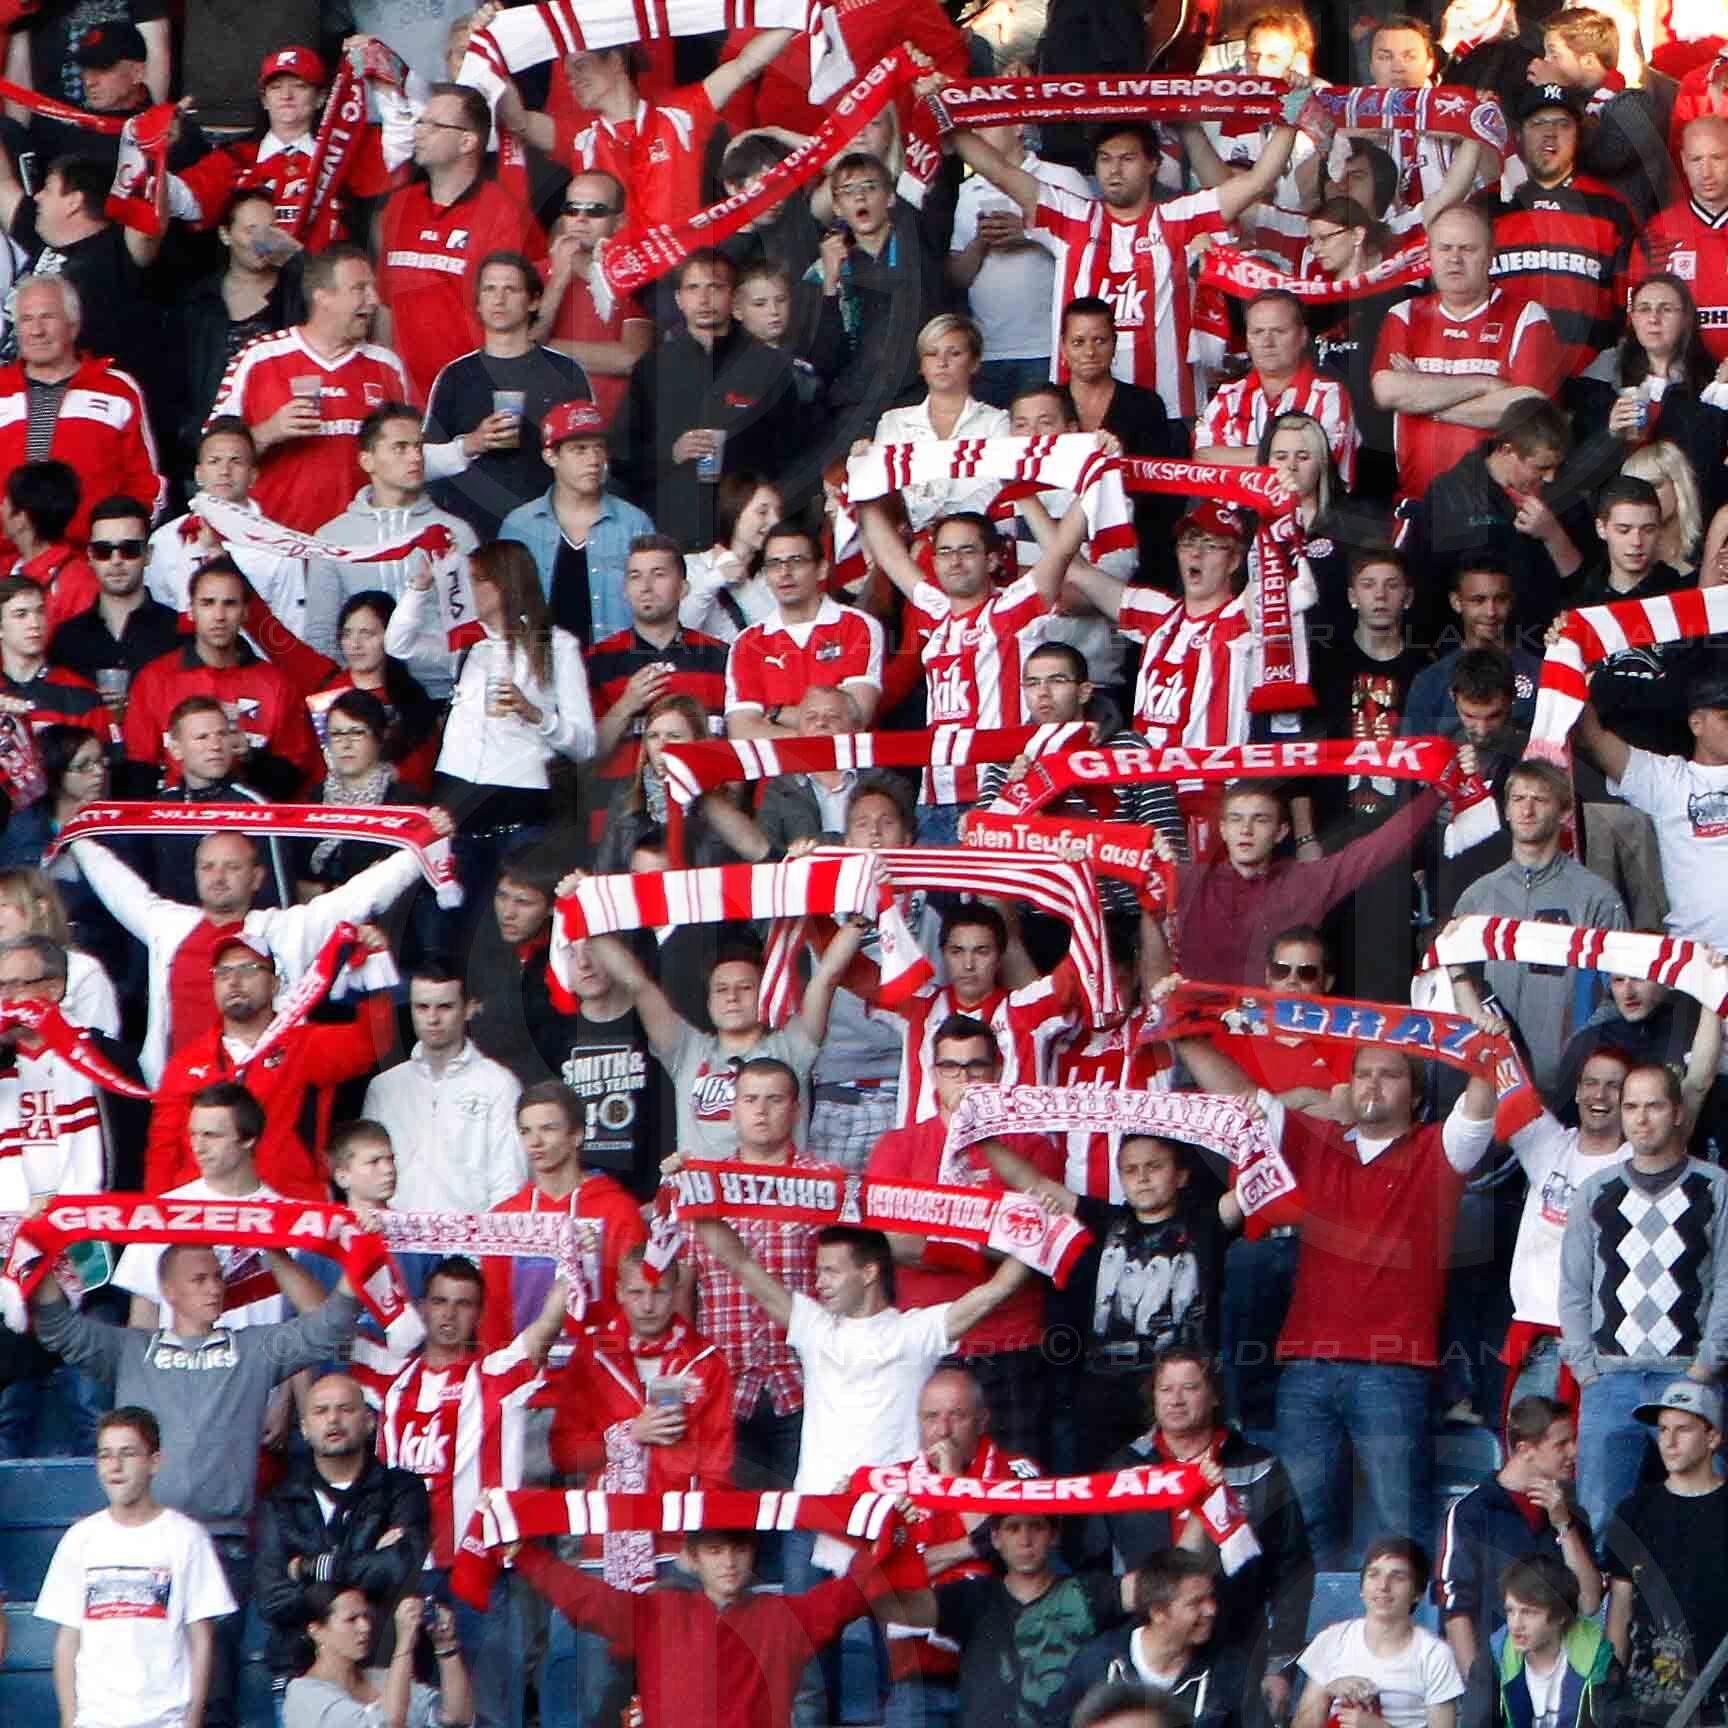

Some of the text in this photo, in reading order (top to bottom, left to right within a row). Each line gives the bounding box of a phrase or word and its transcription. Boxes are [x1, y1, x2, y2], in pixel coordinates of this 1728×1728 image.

[939, 77, 1278, 103] GAK FC LIVERPOOL
[1488, 250, 1602, 281] LIEBHERR
[932, 663, 972, 714] kik
[1142, 667, 1188, 715] kik
[1068, 741, 1430, 778] GRAZER AK
[1016, 824, 1139, 866] Teufel aus
[1277, 998, 1481, 1061] GRAZ
[1243, 1165, 1285, 1208] GAK
[49, 1205, 265, 1234] GRAZER
[399, 1412, 450, 1472] kik
[868, 1463, 1185, 1503] GRAZER AK
